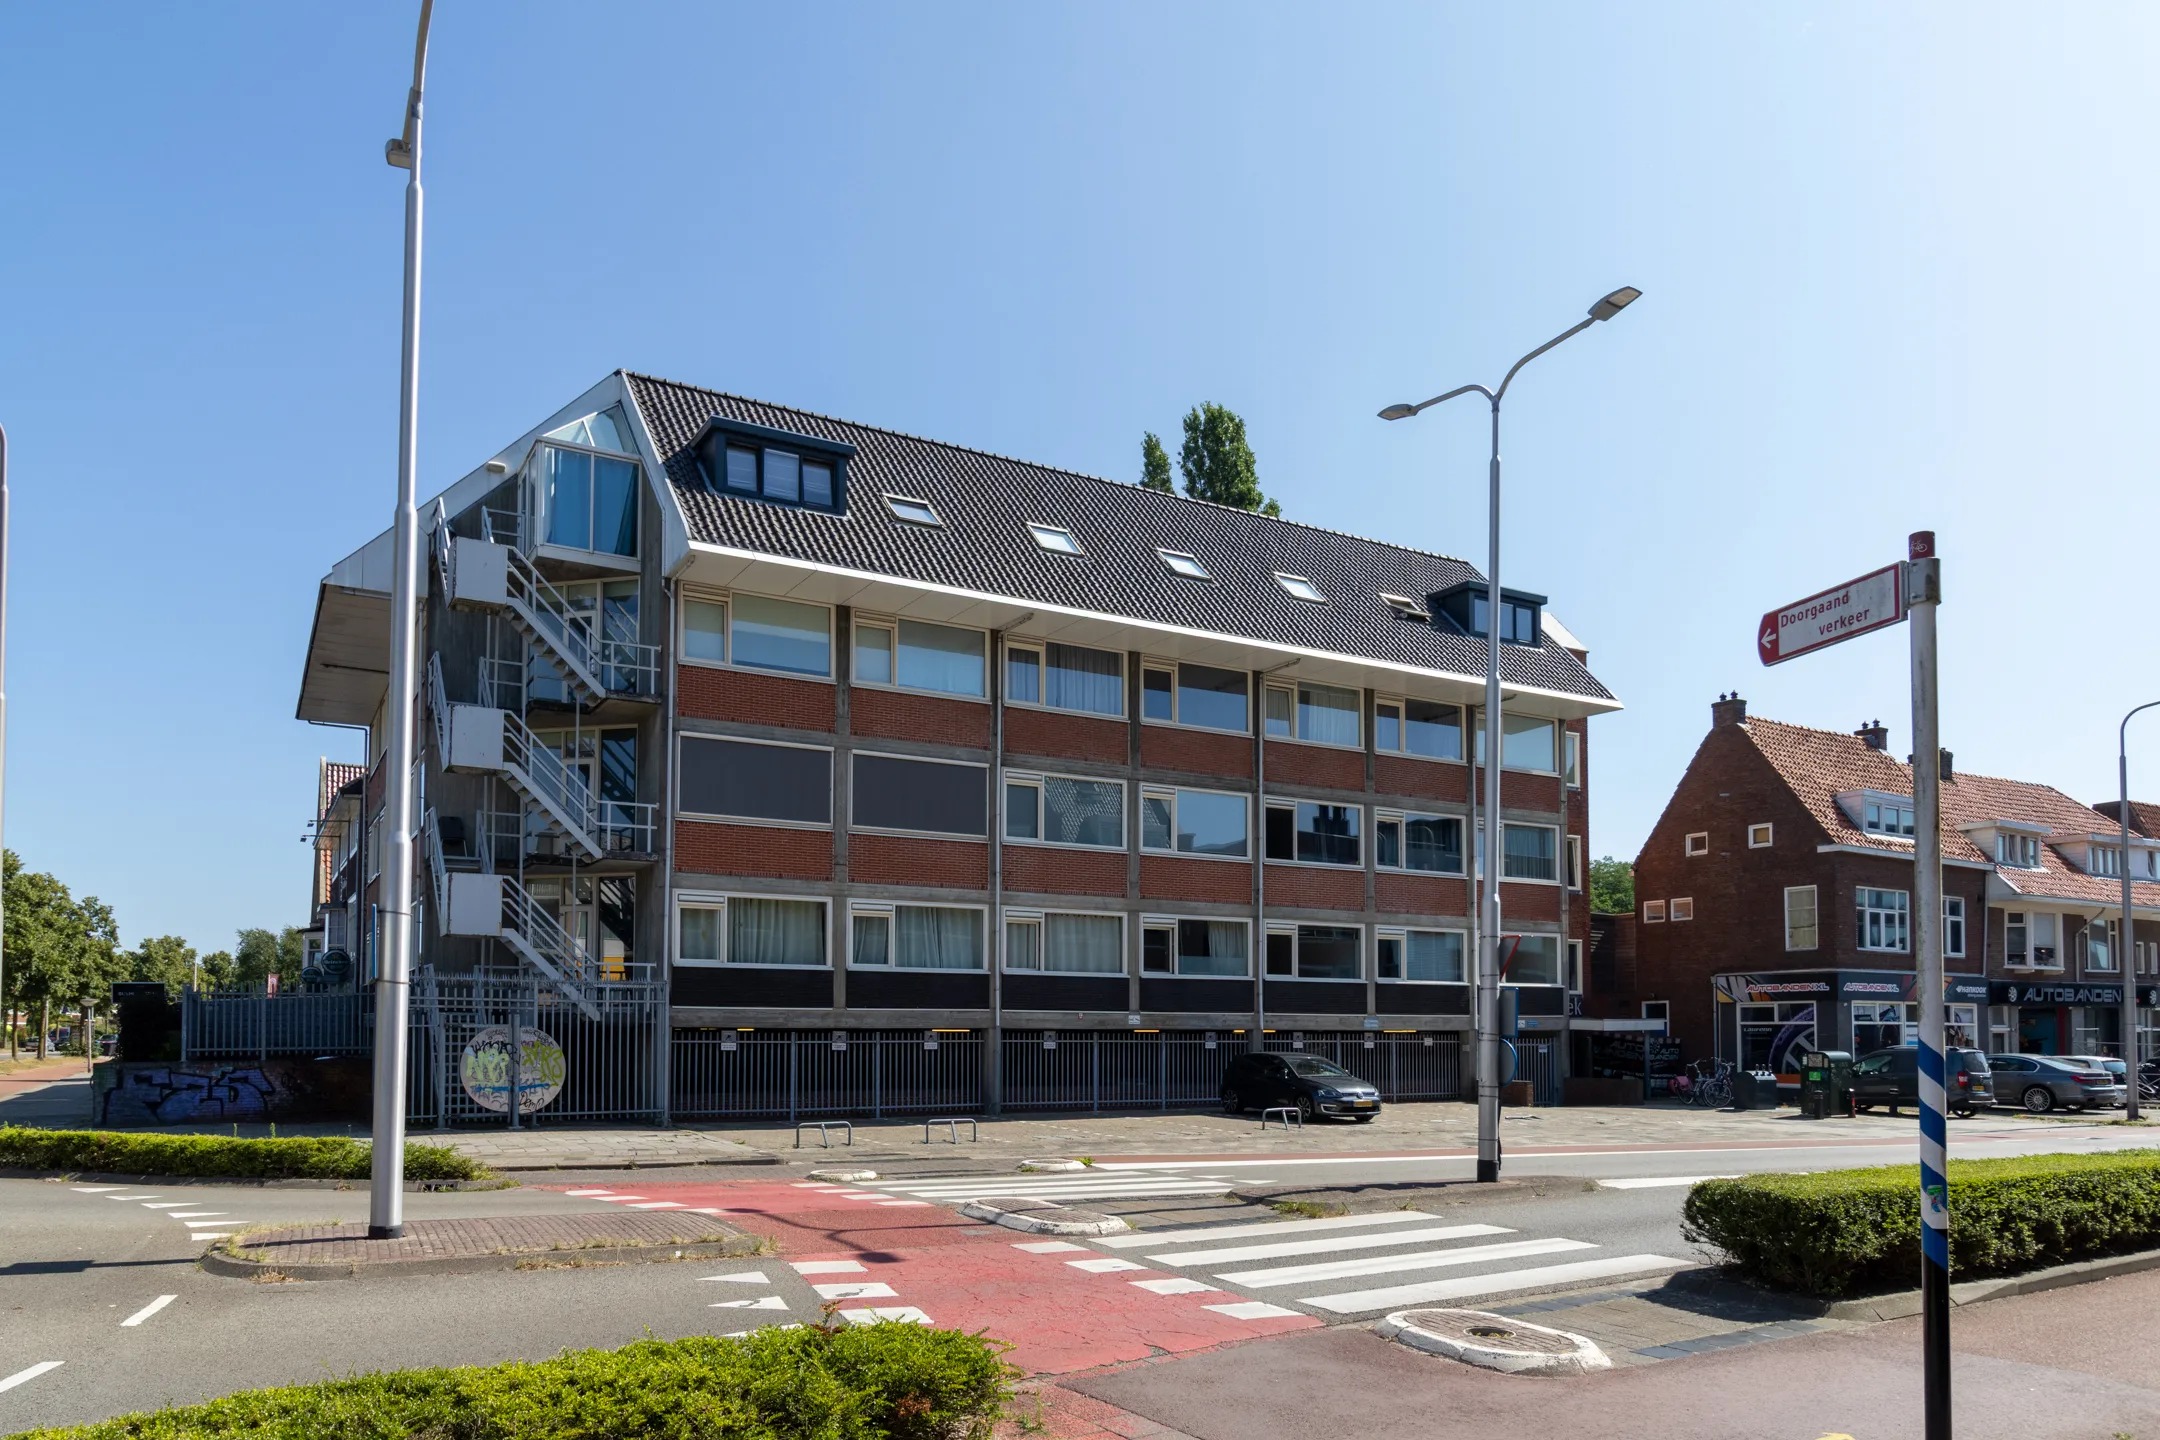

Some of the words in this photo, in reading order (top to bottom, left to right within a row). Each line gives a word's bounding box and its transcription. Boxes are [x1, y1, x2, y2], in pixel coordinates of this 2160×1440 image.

[1781, 590, 1849, 628] Doorgaand
[1818, 608, 1870, 636] verkeer
[2023, 987, 2122, 1003] AUTOBANDEN
